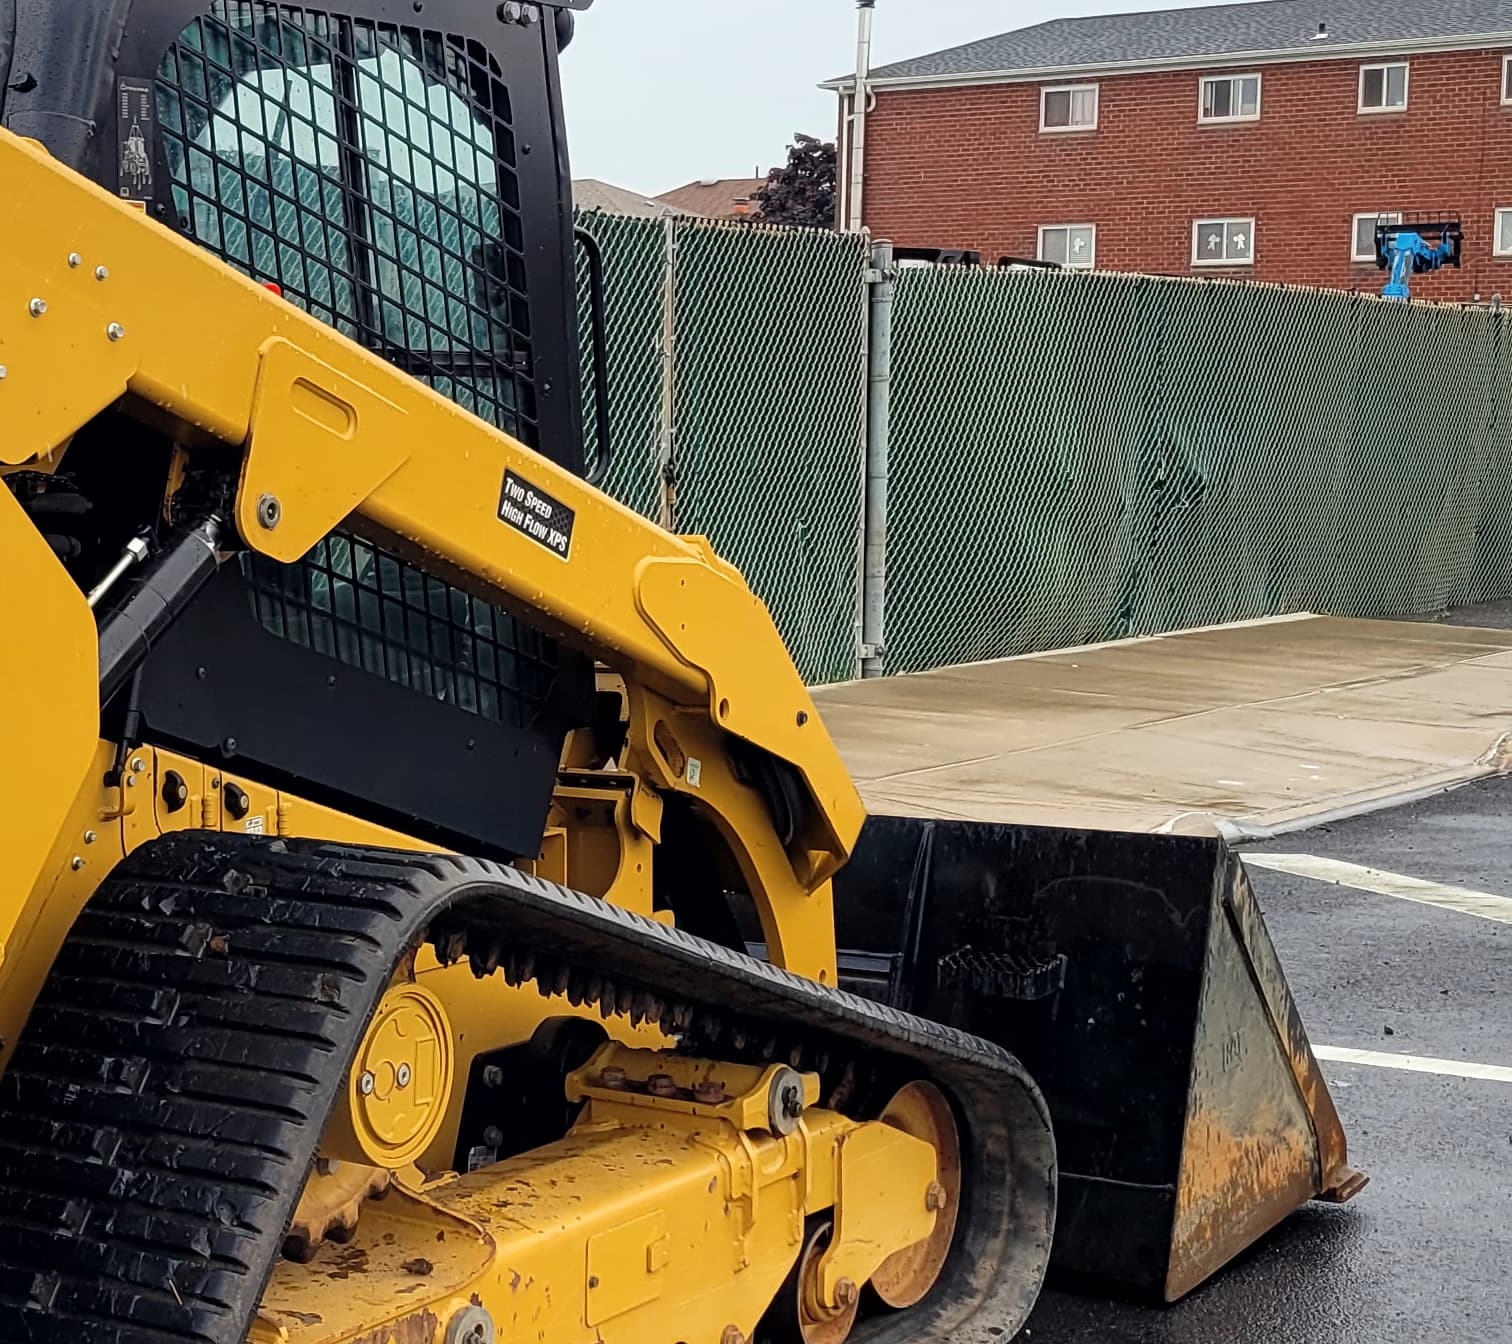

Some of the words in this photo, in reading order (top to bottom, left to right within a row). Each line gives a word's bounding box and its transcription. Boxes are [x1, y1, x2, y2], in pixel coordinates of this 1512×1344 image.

[504, 477, 525, 502] TWO
[524, 491, 553, 518] SPEED
[500, 499, 524, 525] HIGH
[523, 513, 548, 540] FLOW
[546, 528, 568, 552] XPS
